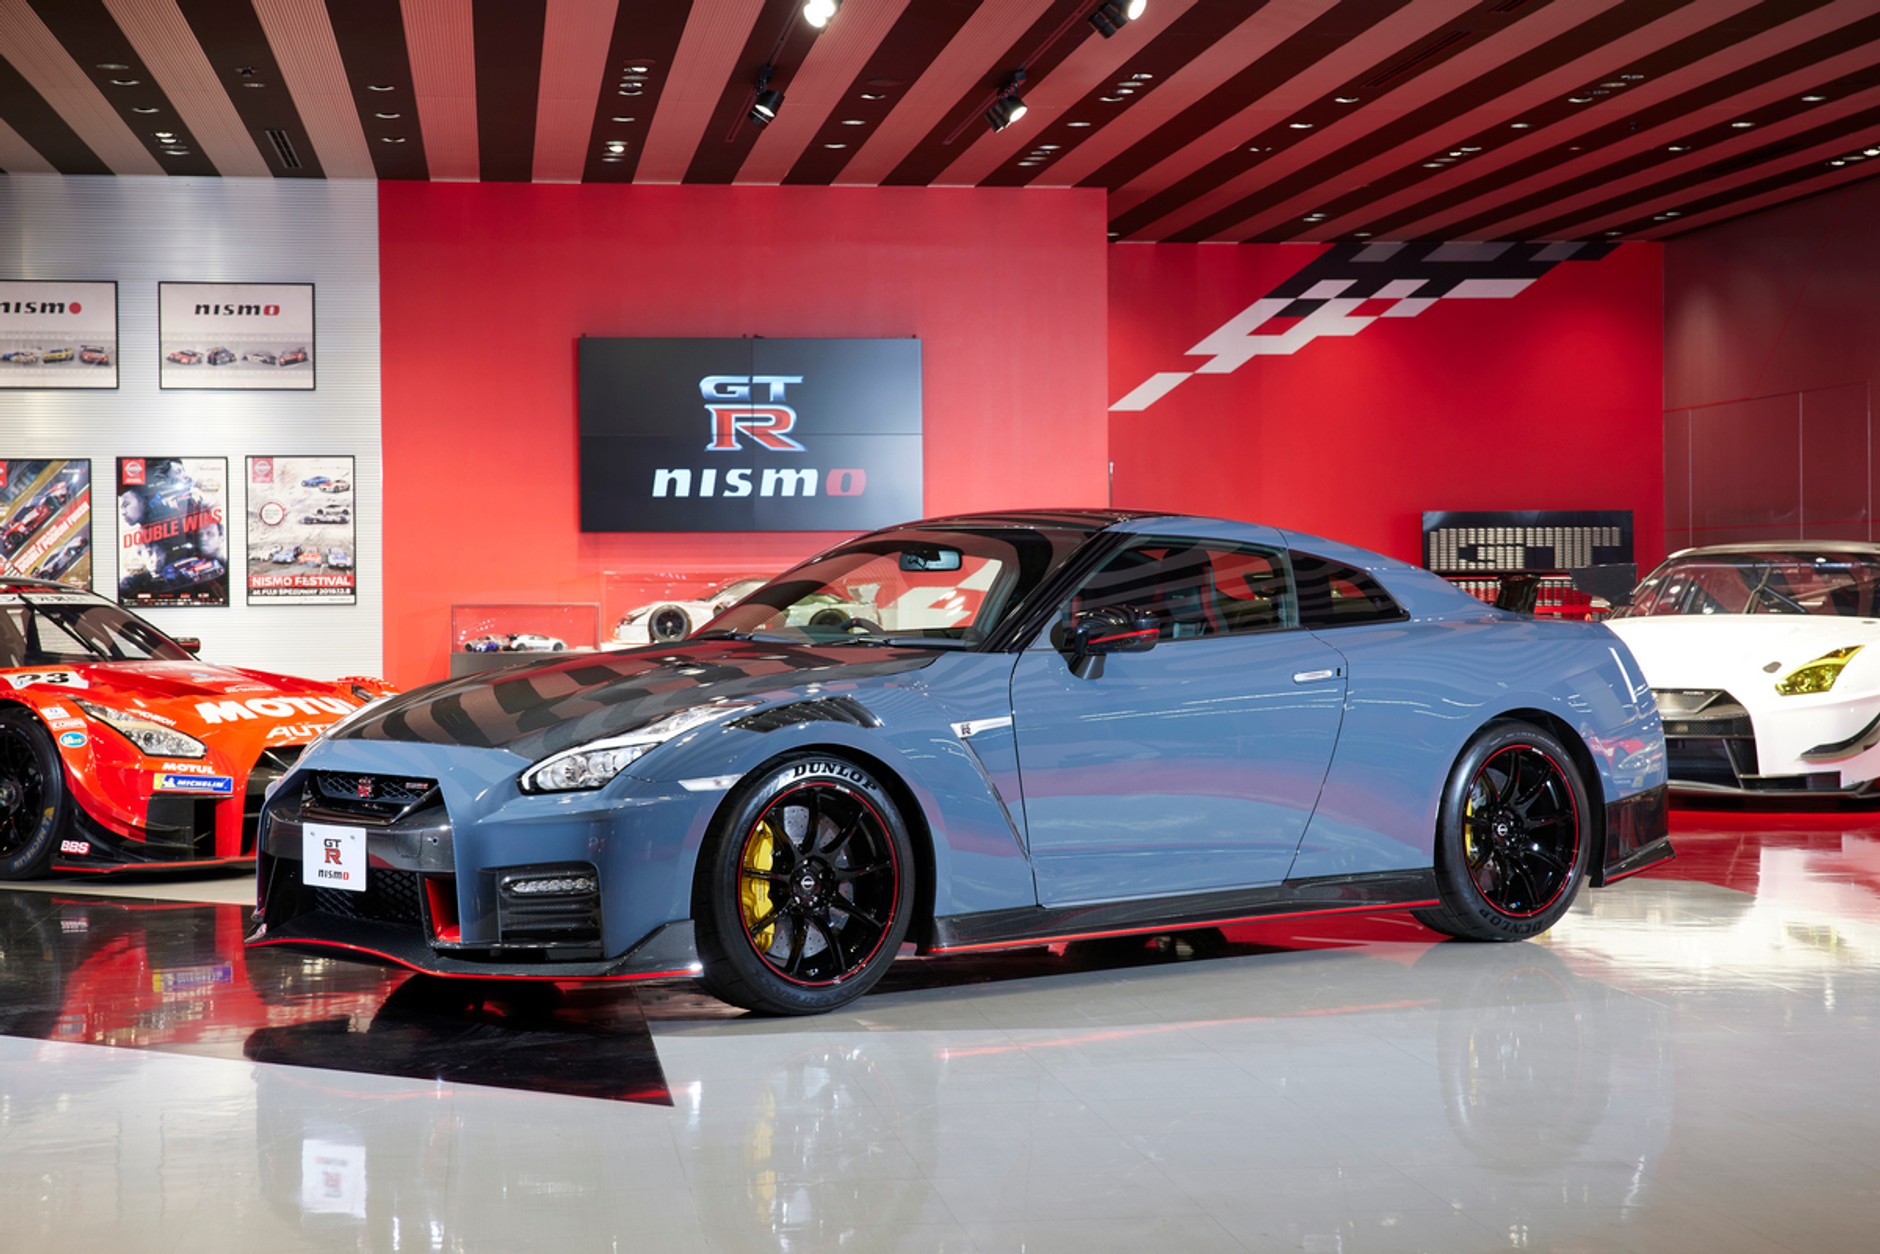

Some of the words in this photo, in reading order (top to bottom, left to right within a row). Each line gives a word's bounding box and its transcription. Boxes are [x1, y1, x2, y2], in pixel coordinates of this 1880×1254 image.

[195, 304, 280, 316] nismo
[699, 375, 804, 402] GT
[704, 404, 808, 452] R
[652, 468, 867, 497] nismo
[123, 519, 180, 549] DOUBLE
[181, 508, 222, 533] WINS
[252, 576, 293, 587] NISMO
[295, 576, 351, 586] FESTIVAL
[265, 723, 335, 740] AUT
[162, 761, 215, 775] MOTUL
[176, 780, 225, 788] MICHELIN
[792, 762, 878, 791] DUNLOP
[60, 839, 90, 855] BBS
[323, 838, 342, 848] GT
[324, 848, 343, 865] R
[317, 869, 349, 881] nismo
